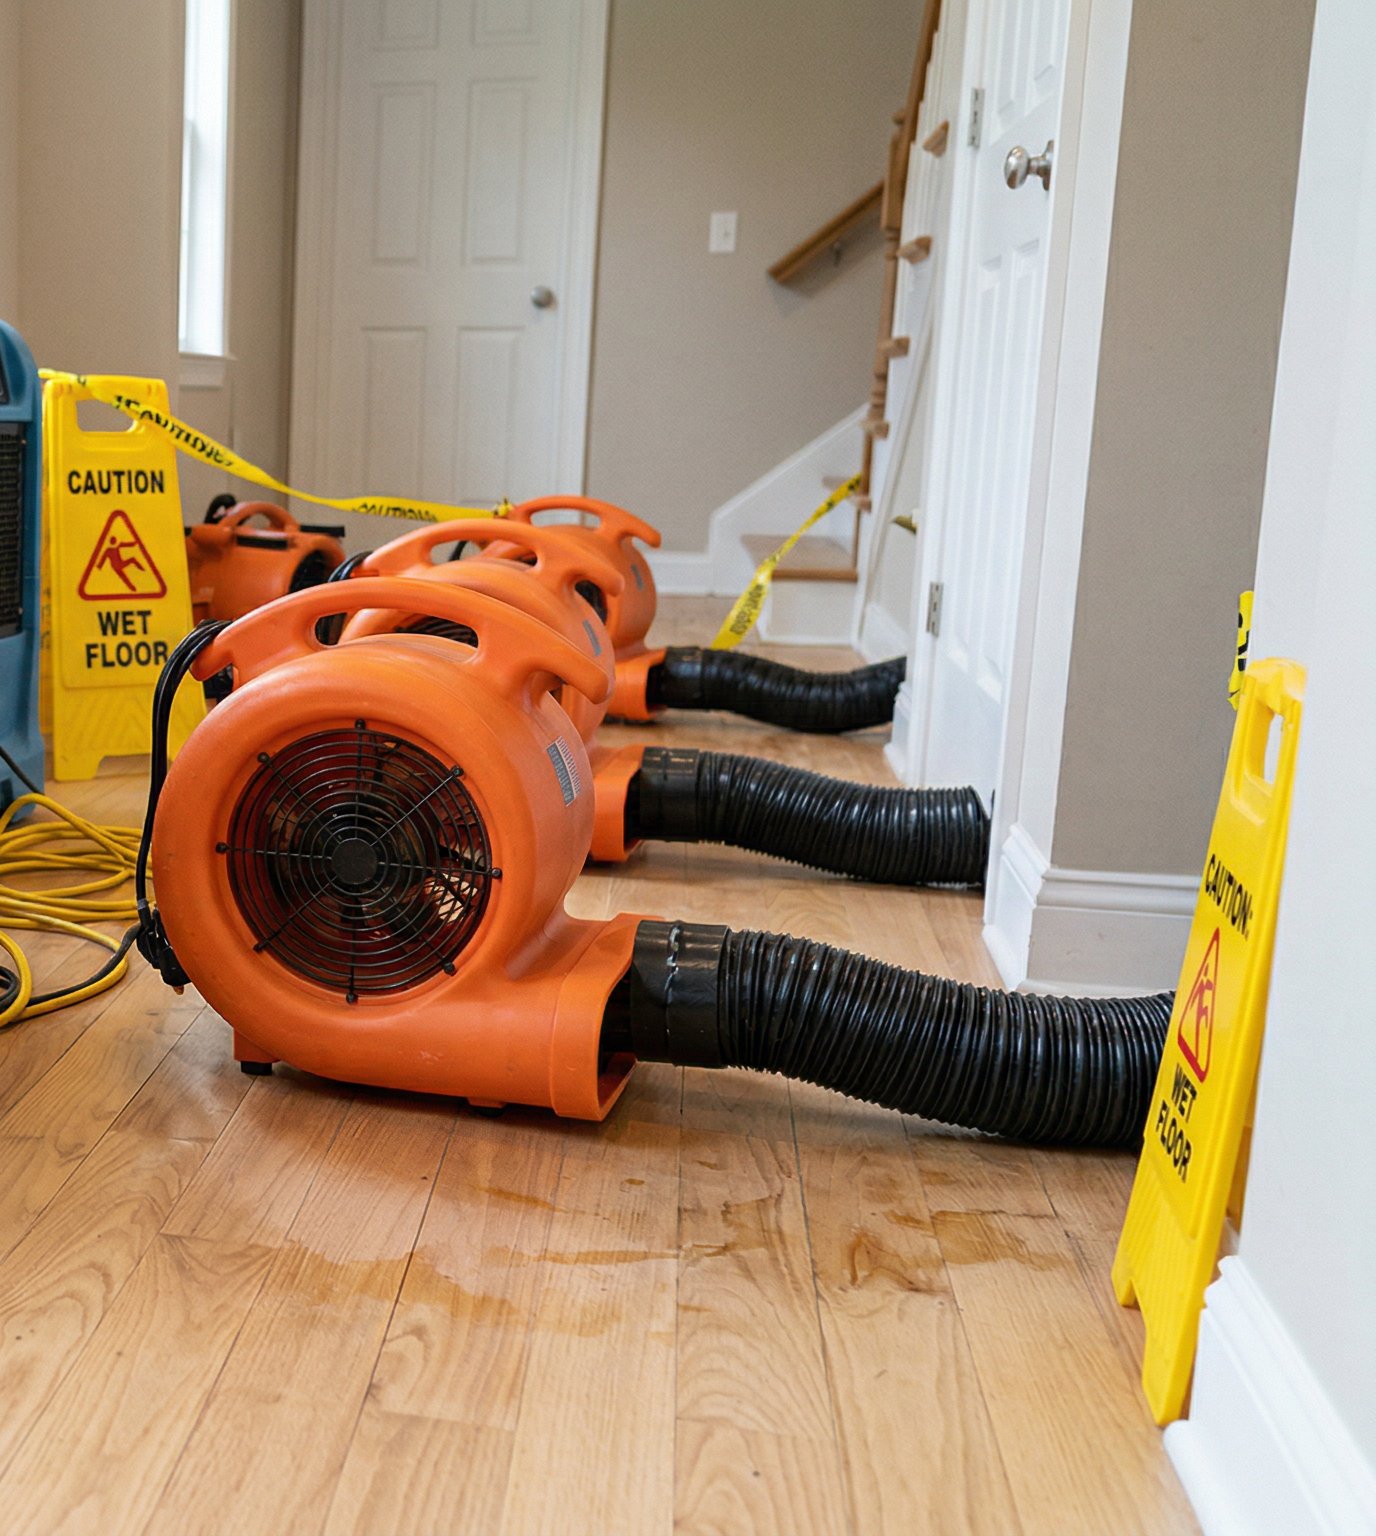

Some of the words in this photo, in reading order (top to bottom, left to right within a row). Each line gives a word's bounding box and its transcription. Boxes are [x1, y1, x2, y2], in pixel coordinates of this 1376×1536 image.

[67, 470, 165, 494] CAUTION
[98, 610, 152, 636] WET
[85, 641, 169, 669] FLOOR
[1171, 1062, 1198, 1124] WET
[1155, 1099, 1192, 1184] FLOOR
